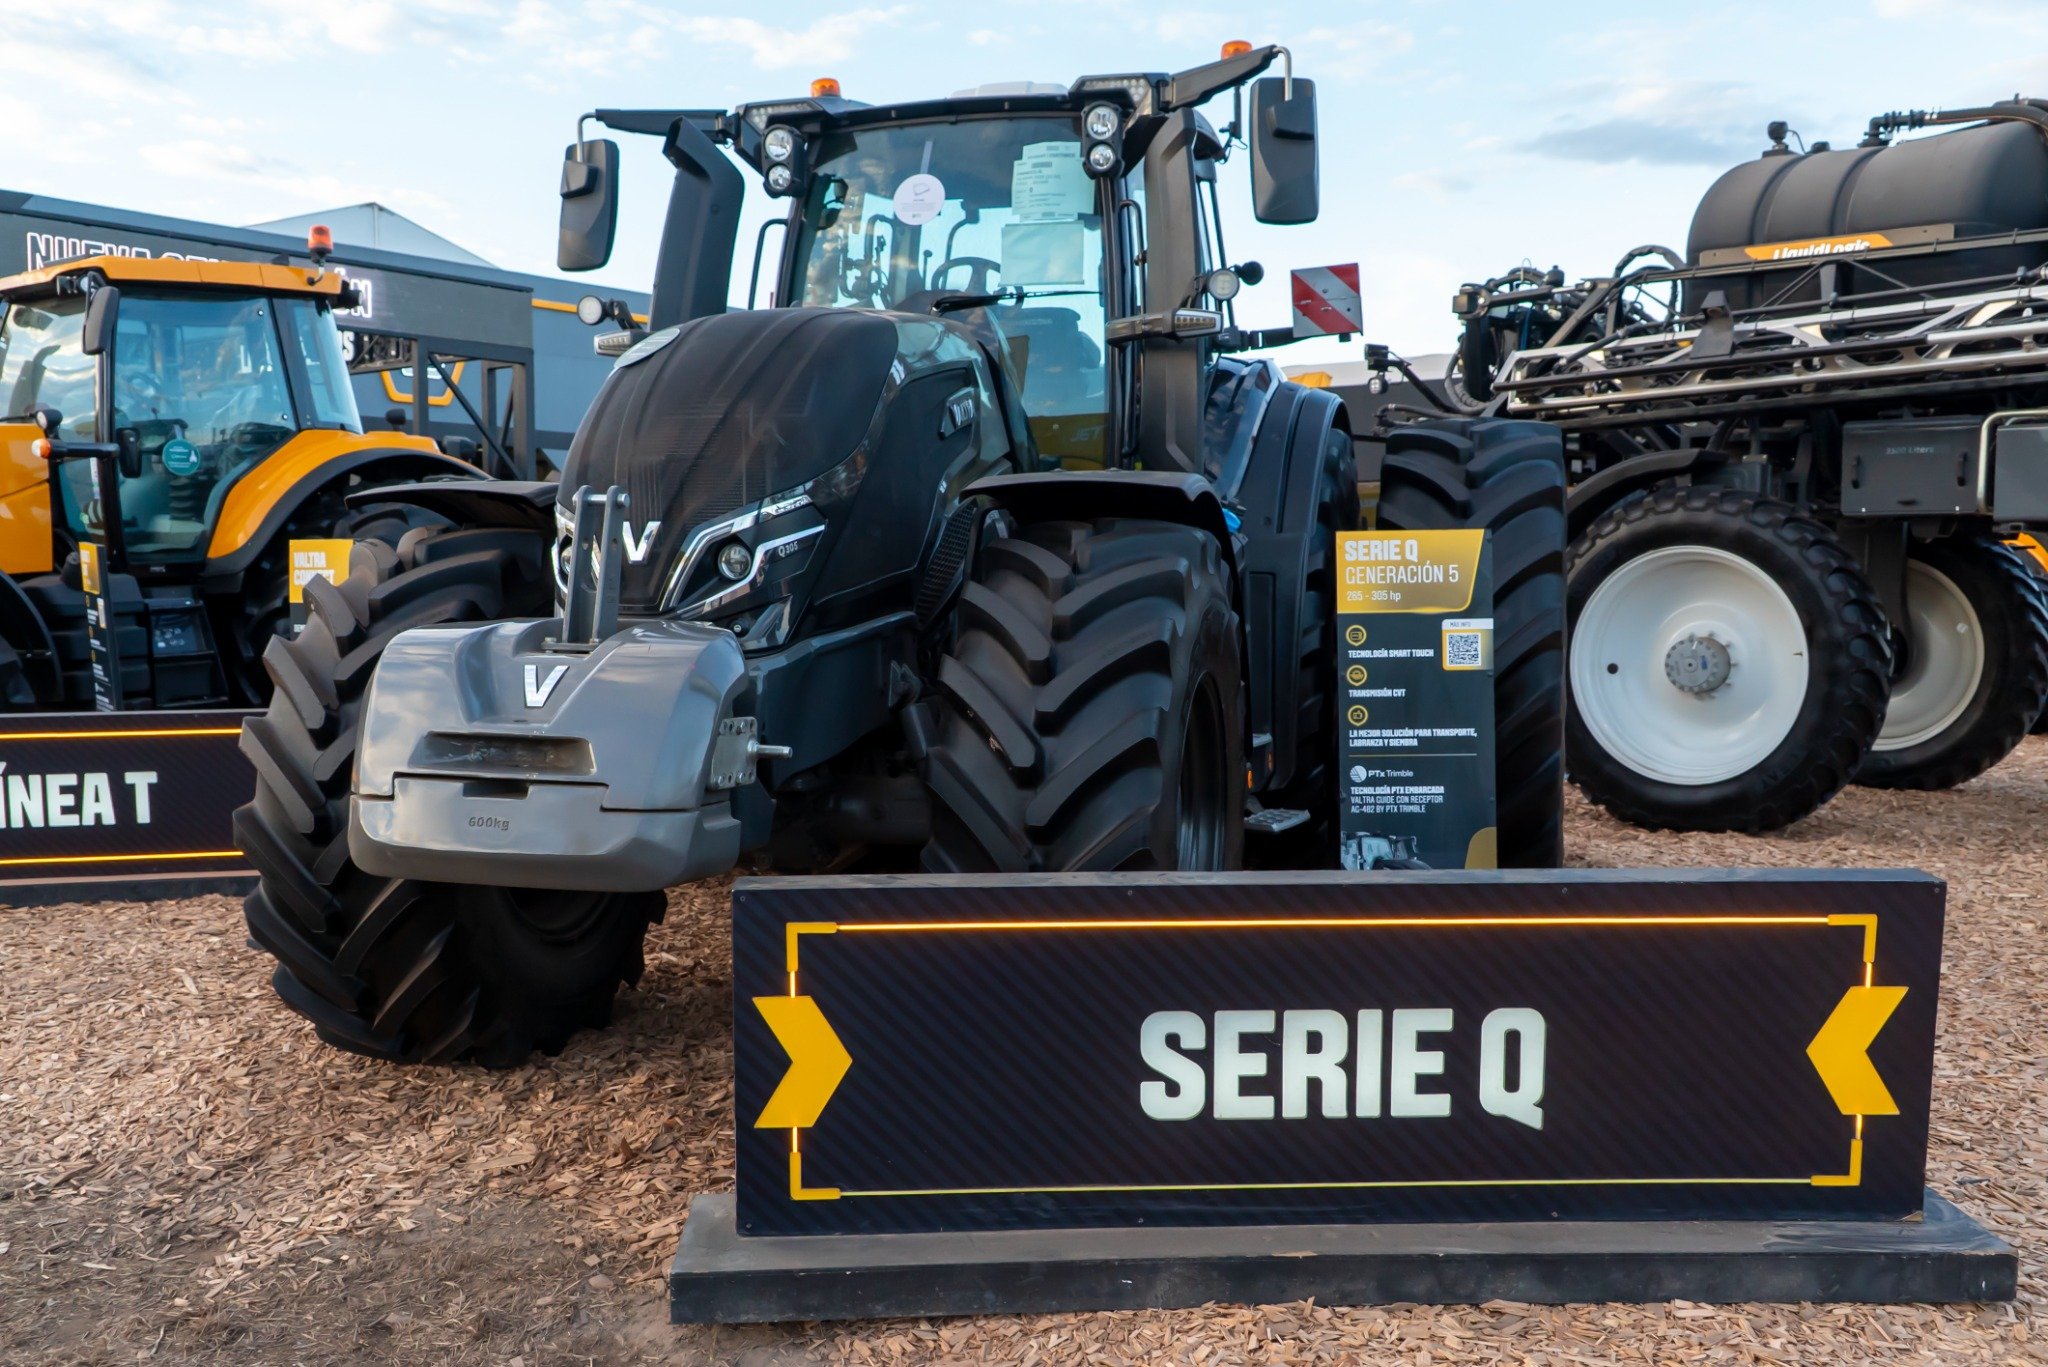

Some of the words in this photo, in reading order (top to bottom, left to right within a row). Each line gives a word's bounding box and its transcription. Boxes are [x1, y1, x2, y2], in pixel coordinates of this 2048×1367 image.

[622, 521, 661, 564] V
[1344, 540, 1401, 562] SERIE
[1405, 539, 1418, 563] Q
[294, 551, 326, 568] VALTRA
[1346, 561, 1443, 584] GENERACIÓN
[1449, 564, 1459, 583] 5
[1389, 590, 1401, 602] hp
[1348, 648, 1388, 658] TECNOLOGÍA
[1389, 649, 1411, 658] SMART
[1412, 649, 1434, 657] TOUCH
[523, 664, 570, 708] V
[1348, 687, 1392, 698] TRANSMISIÓN
[1393, 688, 1406, 697] CVT
[1382, 727, 1414, 737] SOLUCIÓN
[1414, 729, 1431, 737] PARA
[1432, 728, 1477, 738] TRANSPORTE,
[1349, 739, 1383, 747] LABRANZA
[1389, 738, 1418, 746] SIEMBRA
[1386, 769, 1414, 777] Trimble
[1350, 785, 1391, 795] TECNOLOGÍA
[1391, 786, 1405, 794] PTX
[124, 771, 158, 824] T
[1350, 796, 1375, 804] VALTRA
[1410, 795, 1443, 803] RECEPTOR
[1376, 805, 1384, 813] BY
[468, 816, 510, 831] 600kg
[1139, 1008, 1455, 1122] SERIE
[1479, 1007, 1546, 1131] Q
